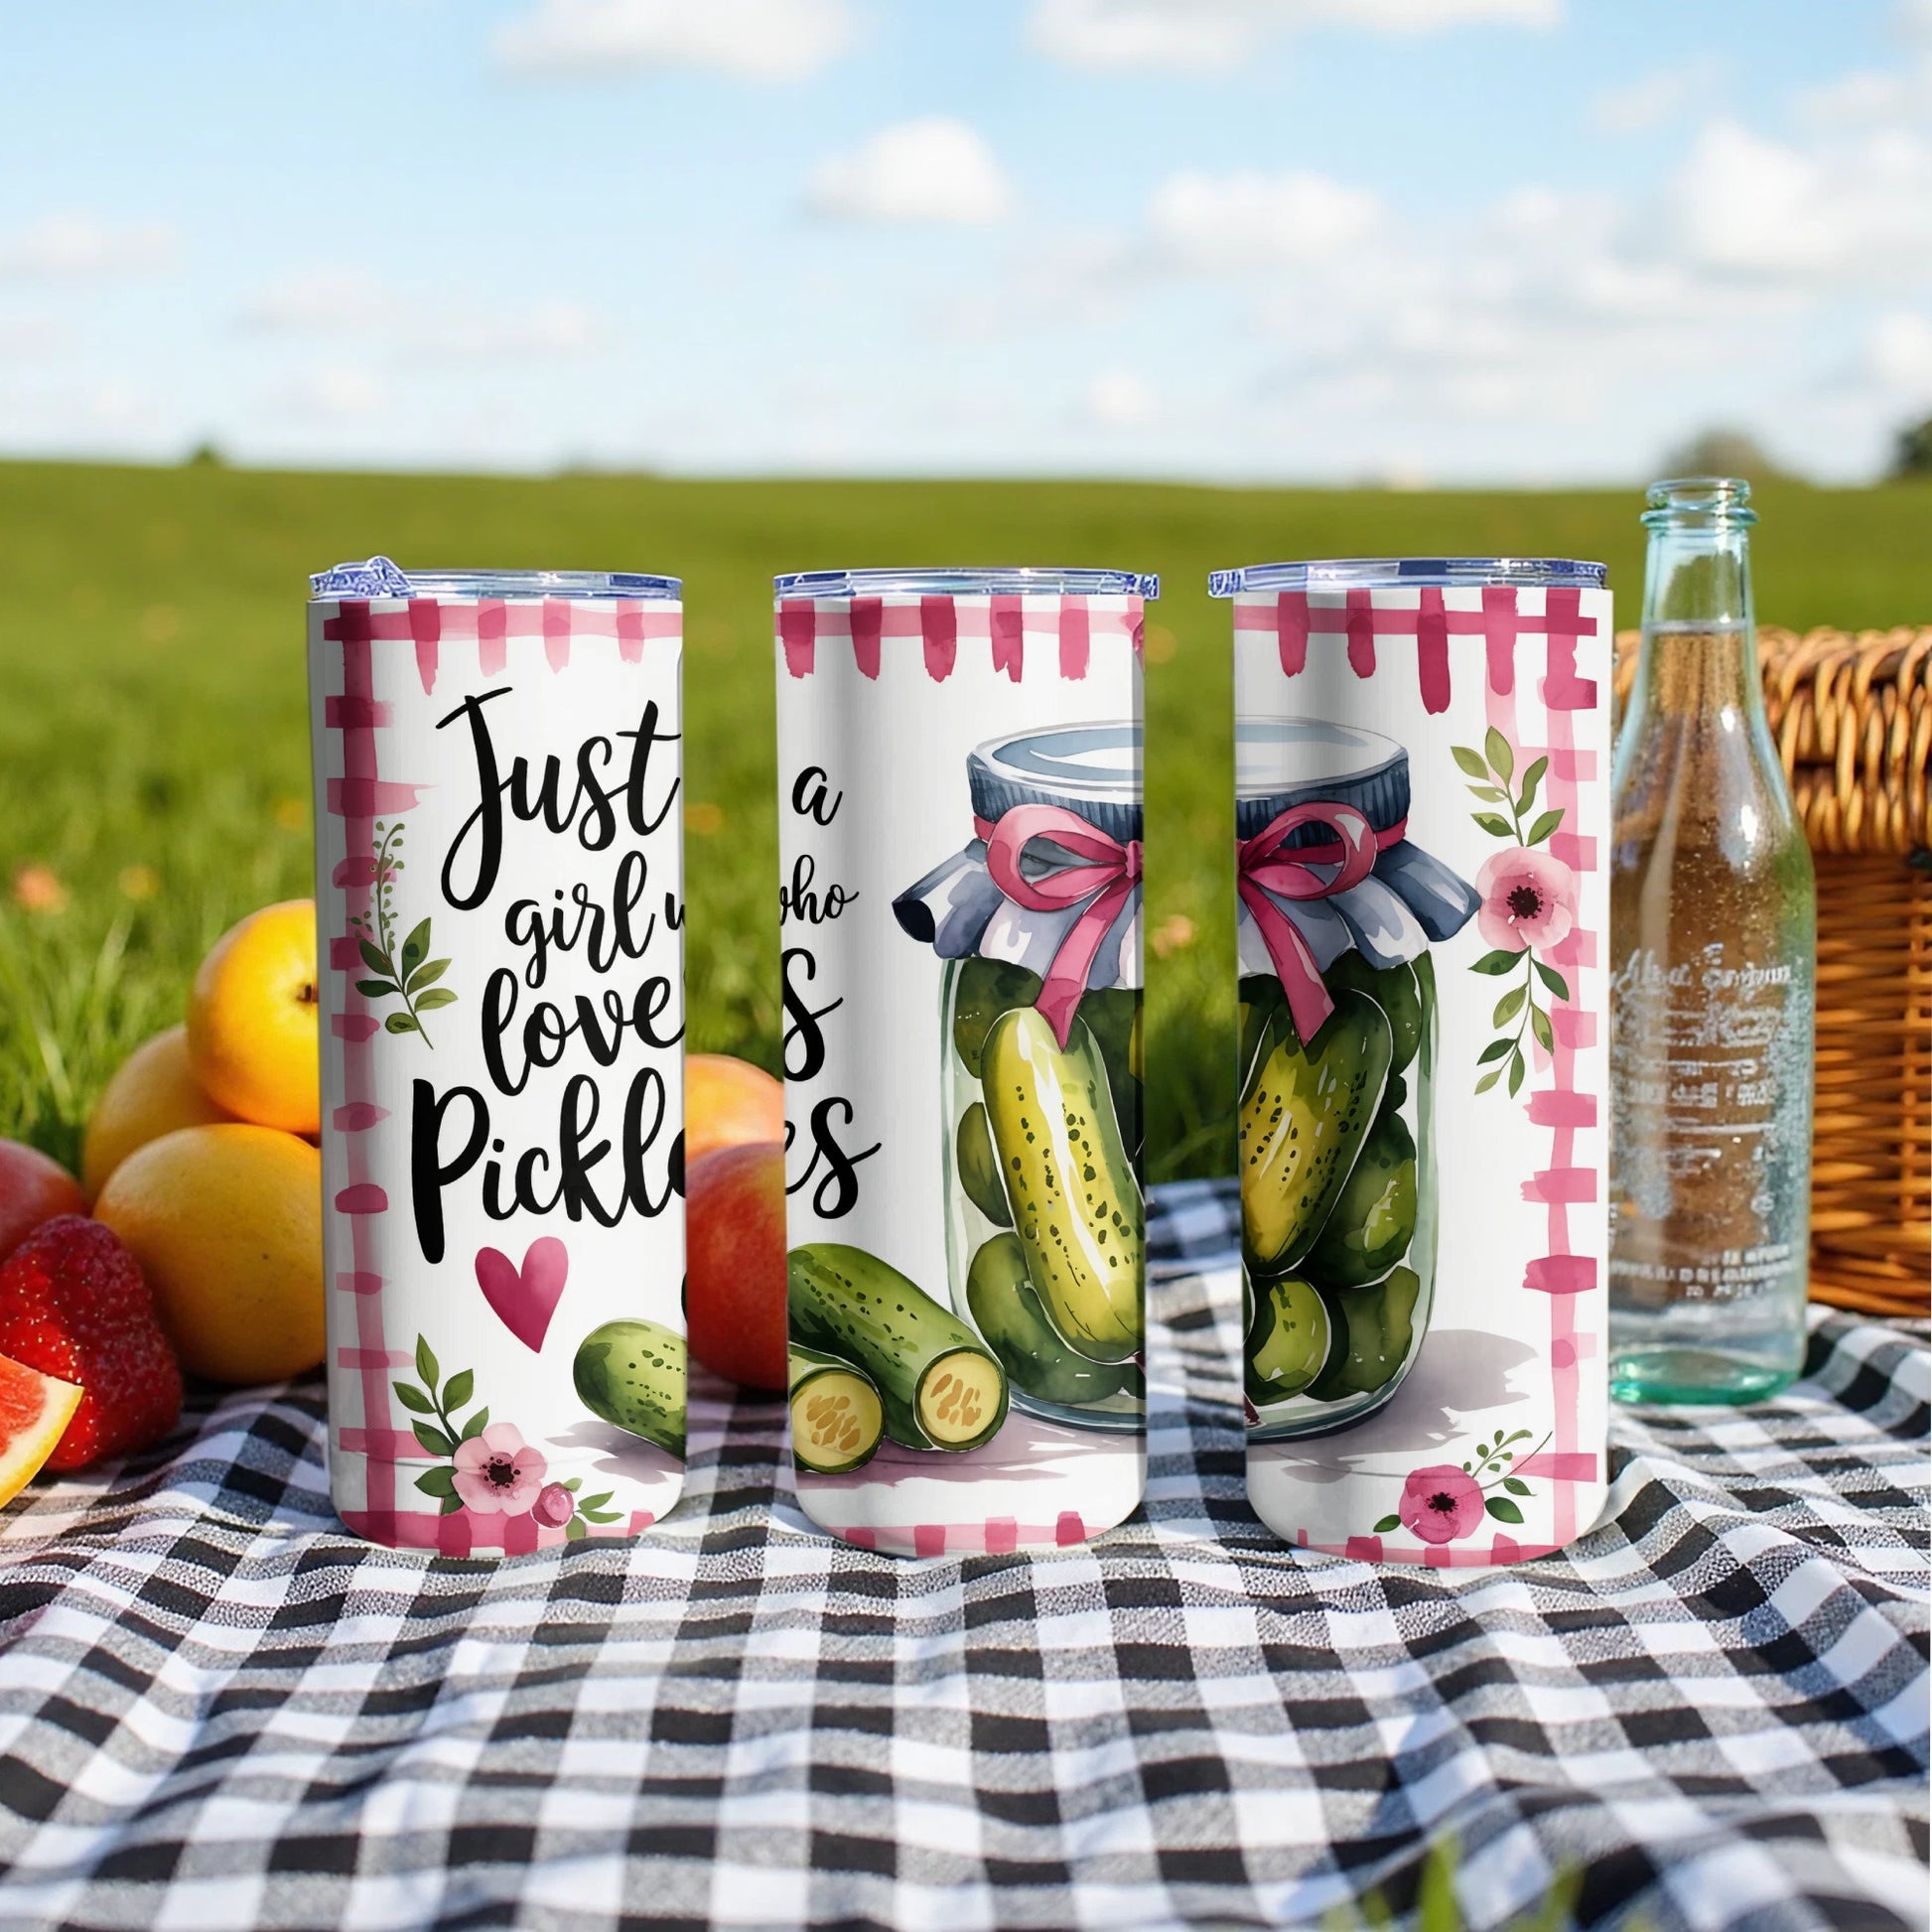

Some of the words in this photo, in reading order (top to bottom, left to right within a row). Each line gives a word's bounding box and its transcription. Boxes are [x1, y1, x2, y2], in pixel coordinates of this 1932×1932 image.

[435, 686, 683, 911] Just
[791, 765, 844, 826] a
[504, 850, 657, 989] girl
[482, 967, 686, 1097] love
